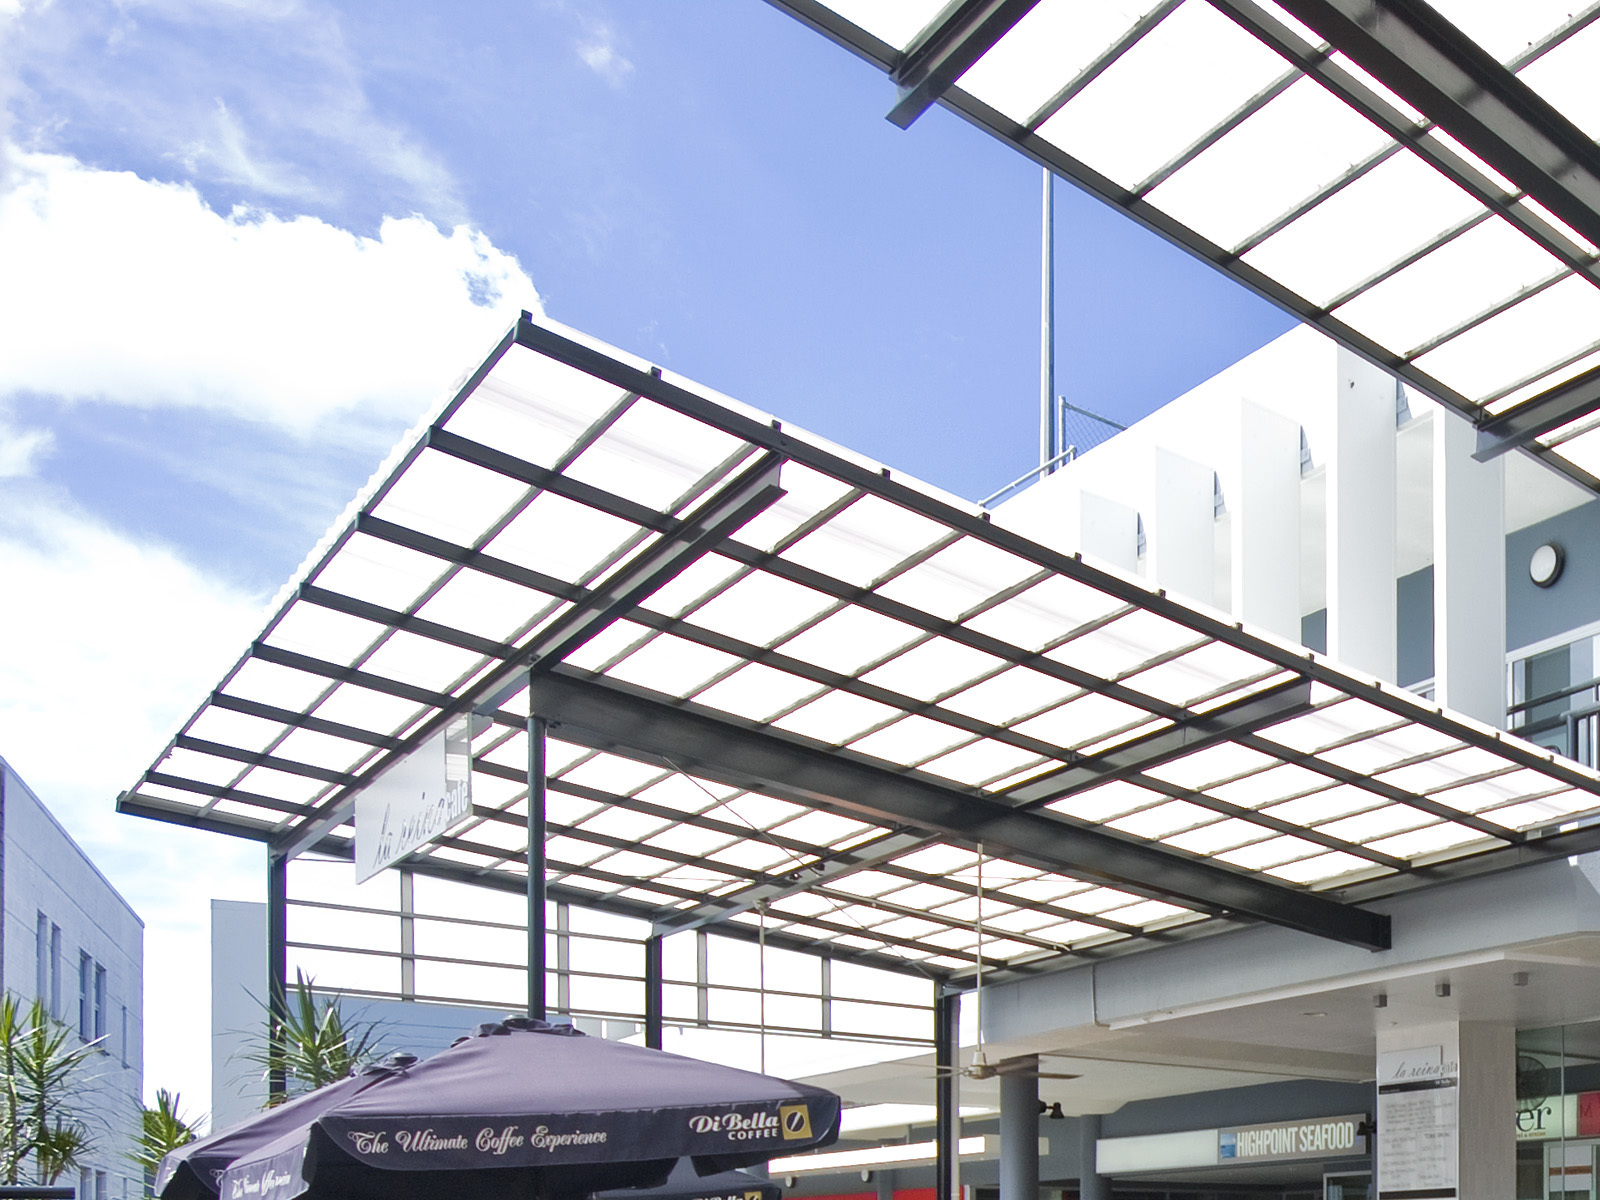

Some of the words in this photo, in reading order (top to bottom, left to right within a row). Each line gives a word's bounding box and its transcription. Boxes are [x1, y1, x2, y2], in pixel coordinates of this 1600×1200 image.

[721, 1111, 780, 1131] Bella
[347, 1131, 389, 1154] The
[395, 1128, 468, 1152] Ultimate
[475, 1126, 524, 1155] Coffee
[530, 1125, 607, 1152] Experience
[727, 1127, 778, 1141] COFFEE
[1236, 1127, 1298, 1158] HIGHPOINT
[1300, 1121, 1354, 1152] SEAFOOD
